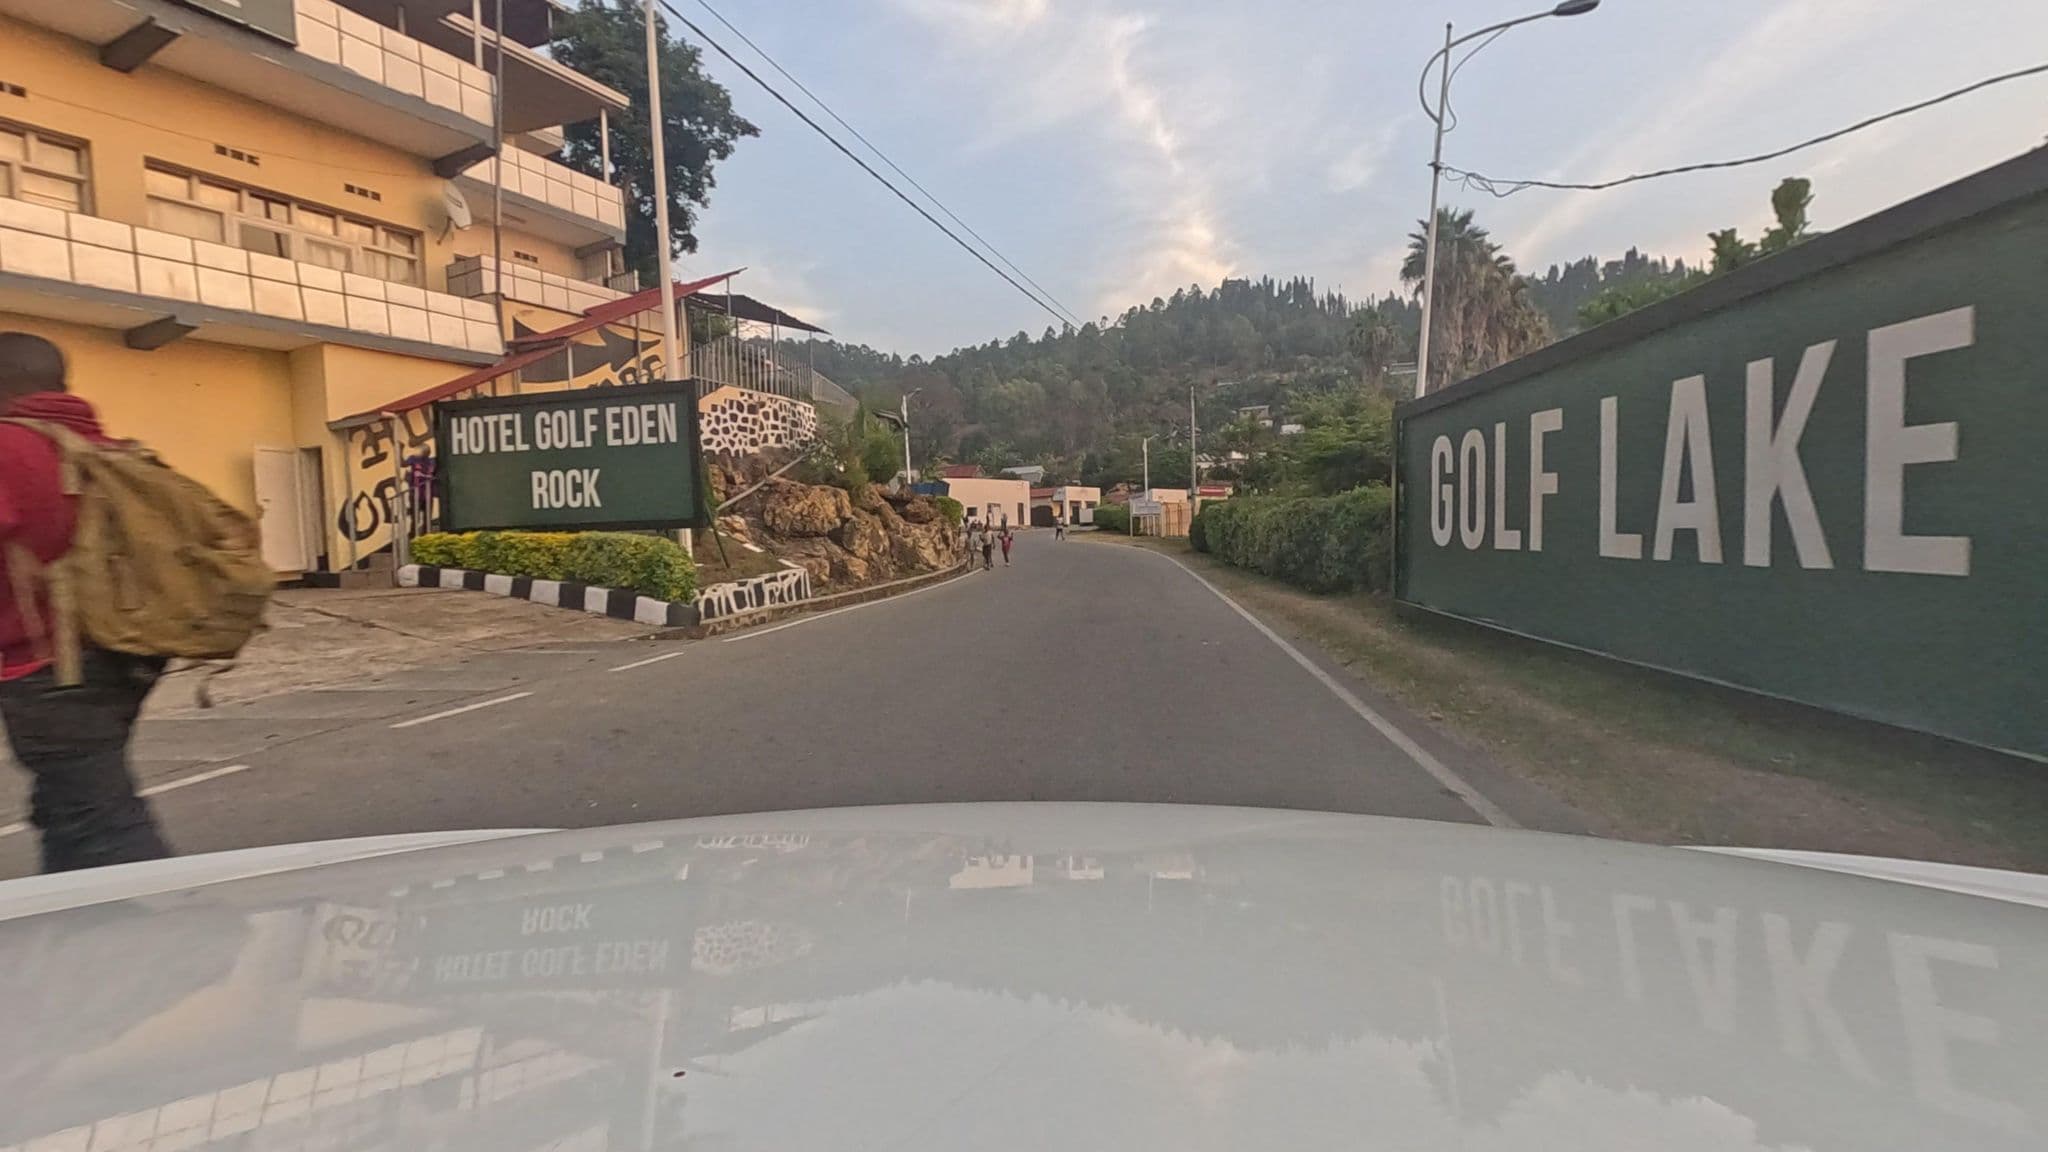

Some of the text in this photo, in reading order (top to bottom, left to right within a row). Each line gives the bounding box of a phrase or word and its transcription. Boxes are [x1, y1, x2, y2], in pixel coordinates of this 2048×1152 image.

[451, 413, 530, 455] HOTEL
[535, 408, 599, 450] GOLF
[605, 403, 678, 447] EDEN
[1430, 304, 1976, 577] GOLF LAKE
[531, 468, 602, 509] ROCK
